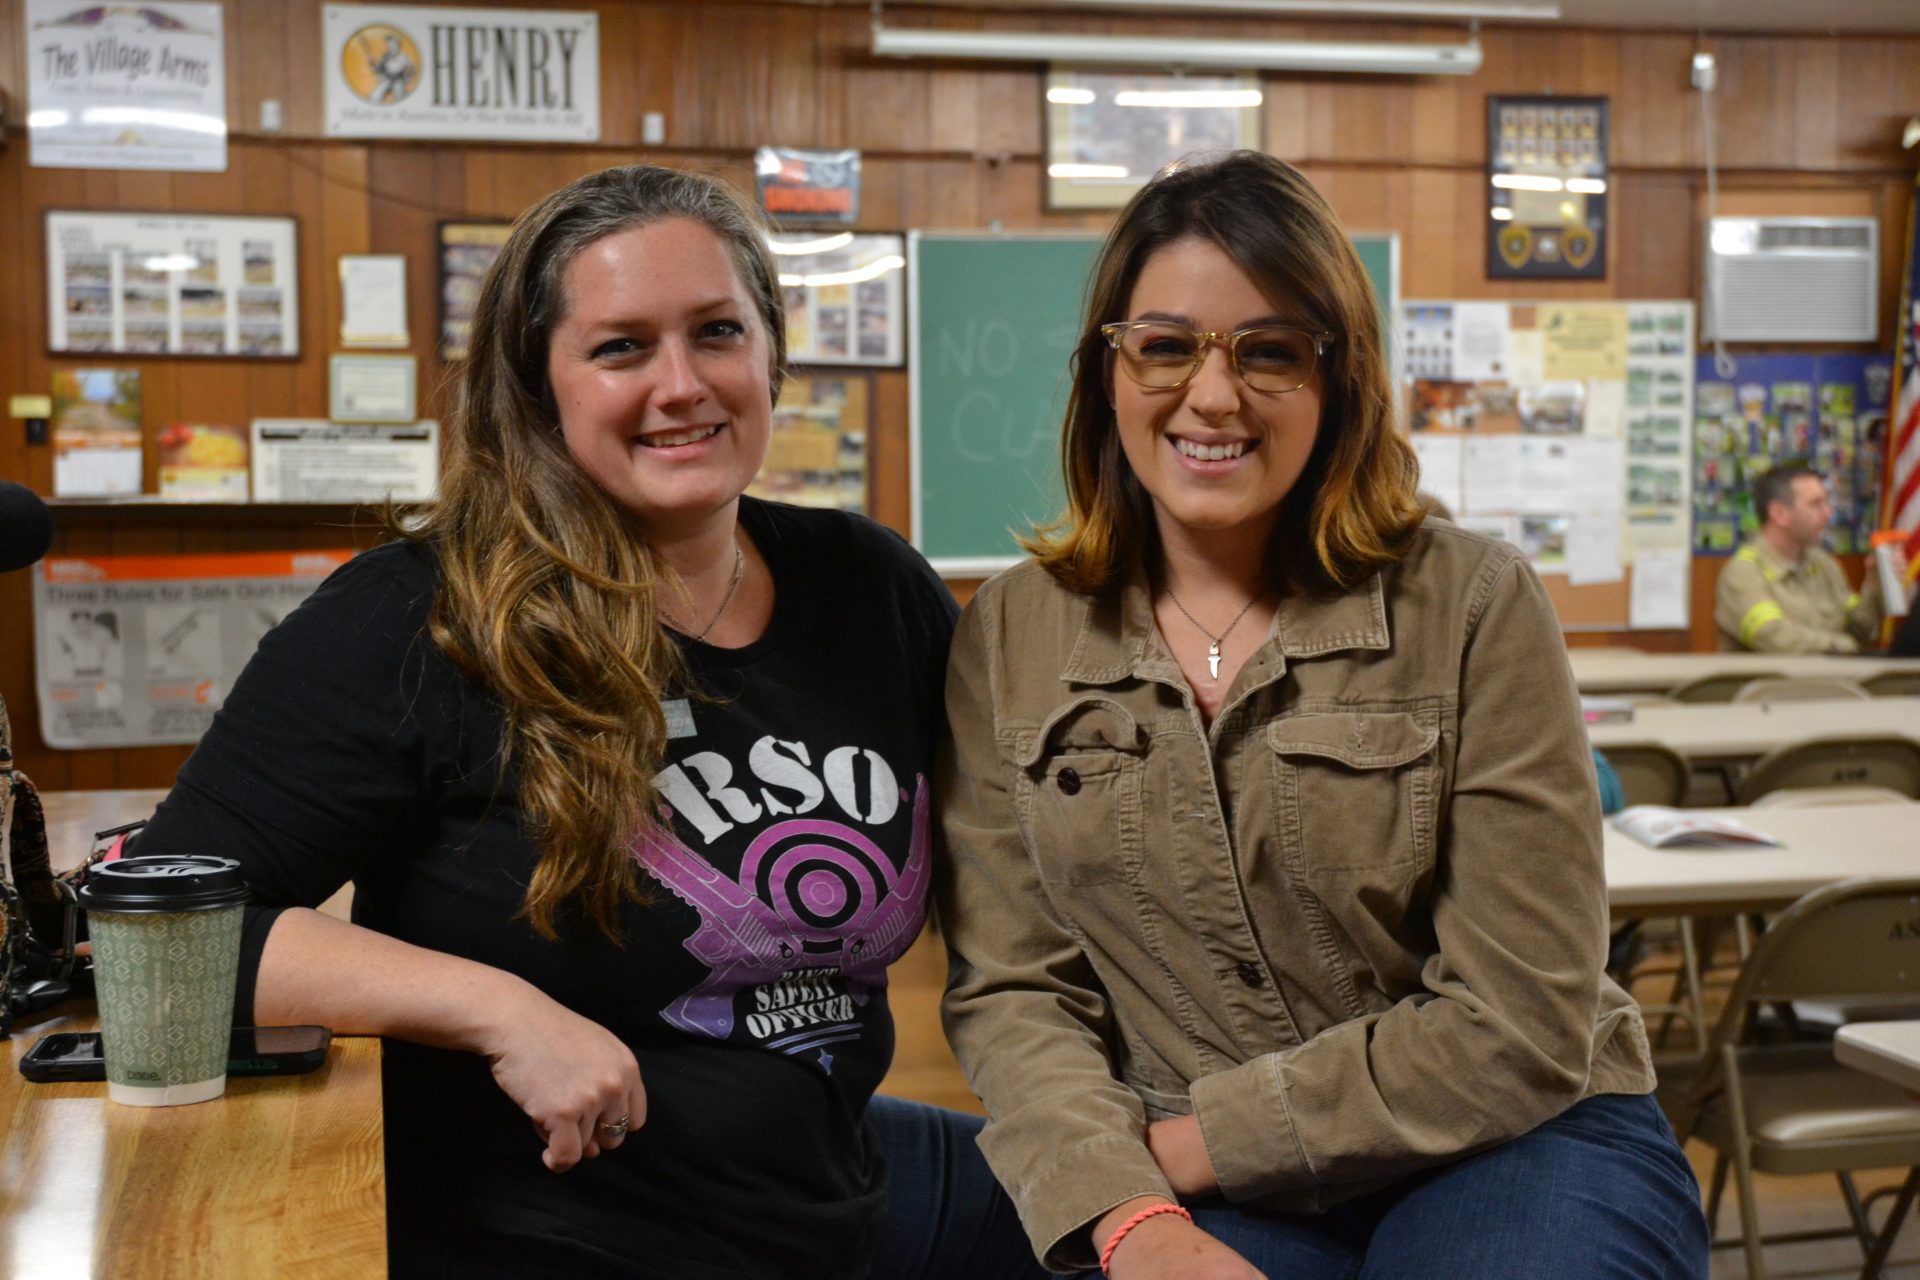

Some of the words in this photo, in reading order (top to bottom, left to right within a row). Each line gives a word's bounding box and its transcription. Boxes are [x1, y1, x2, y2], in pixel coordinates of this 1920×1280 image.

[43, 42, 79, 81] The
[84, 34, 152, 81] Village
[157, 45, 211, 88] Arms
[430, 23, 584, 110] HENRY
[938, 319, 1019, 377] NO
[160, 584, 183, 602] for
[191, 583, 230, 601] Safe
[650, 734, 900, 845] RSO
[745, 994, 855, 1039] OFFICER
